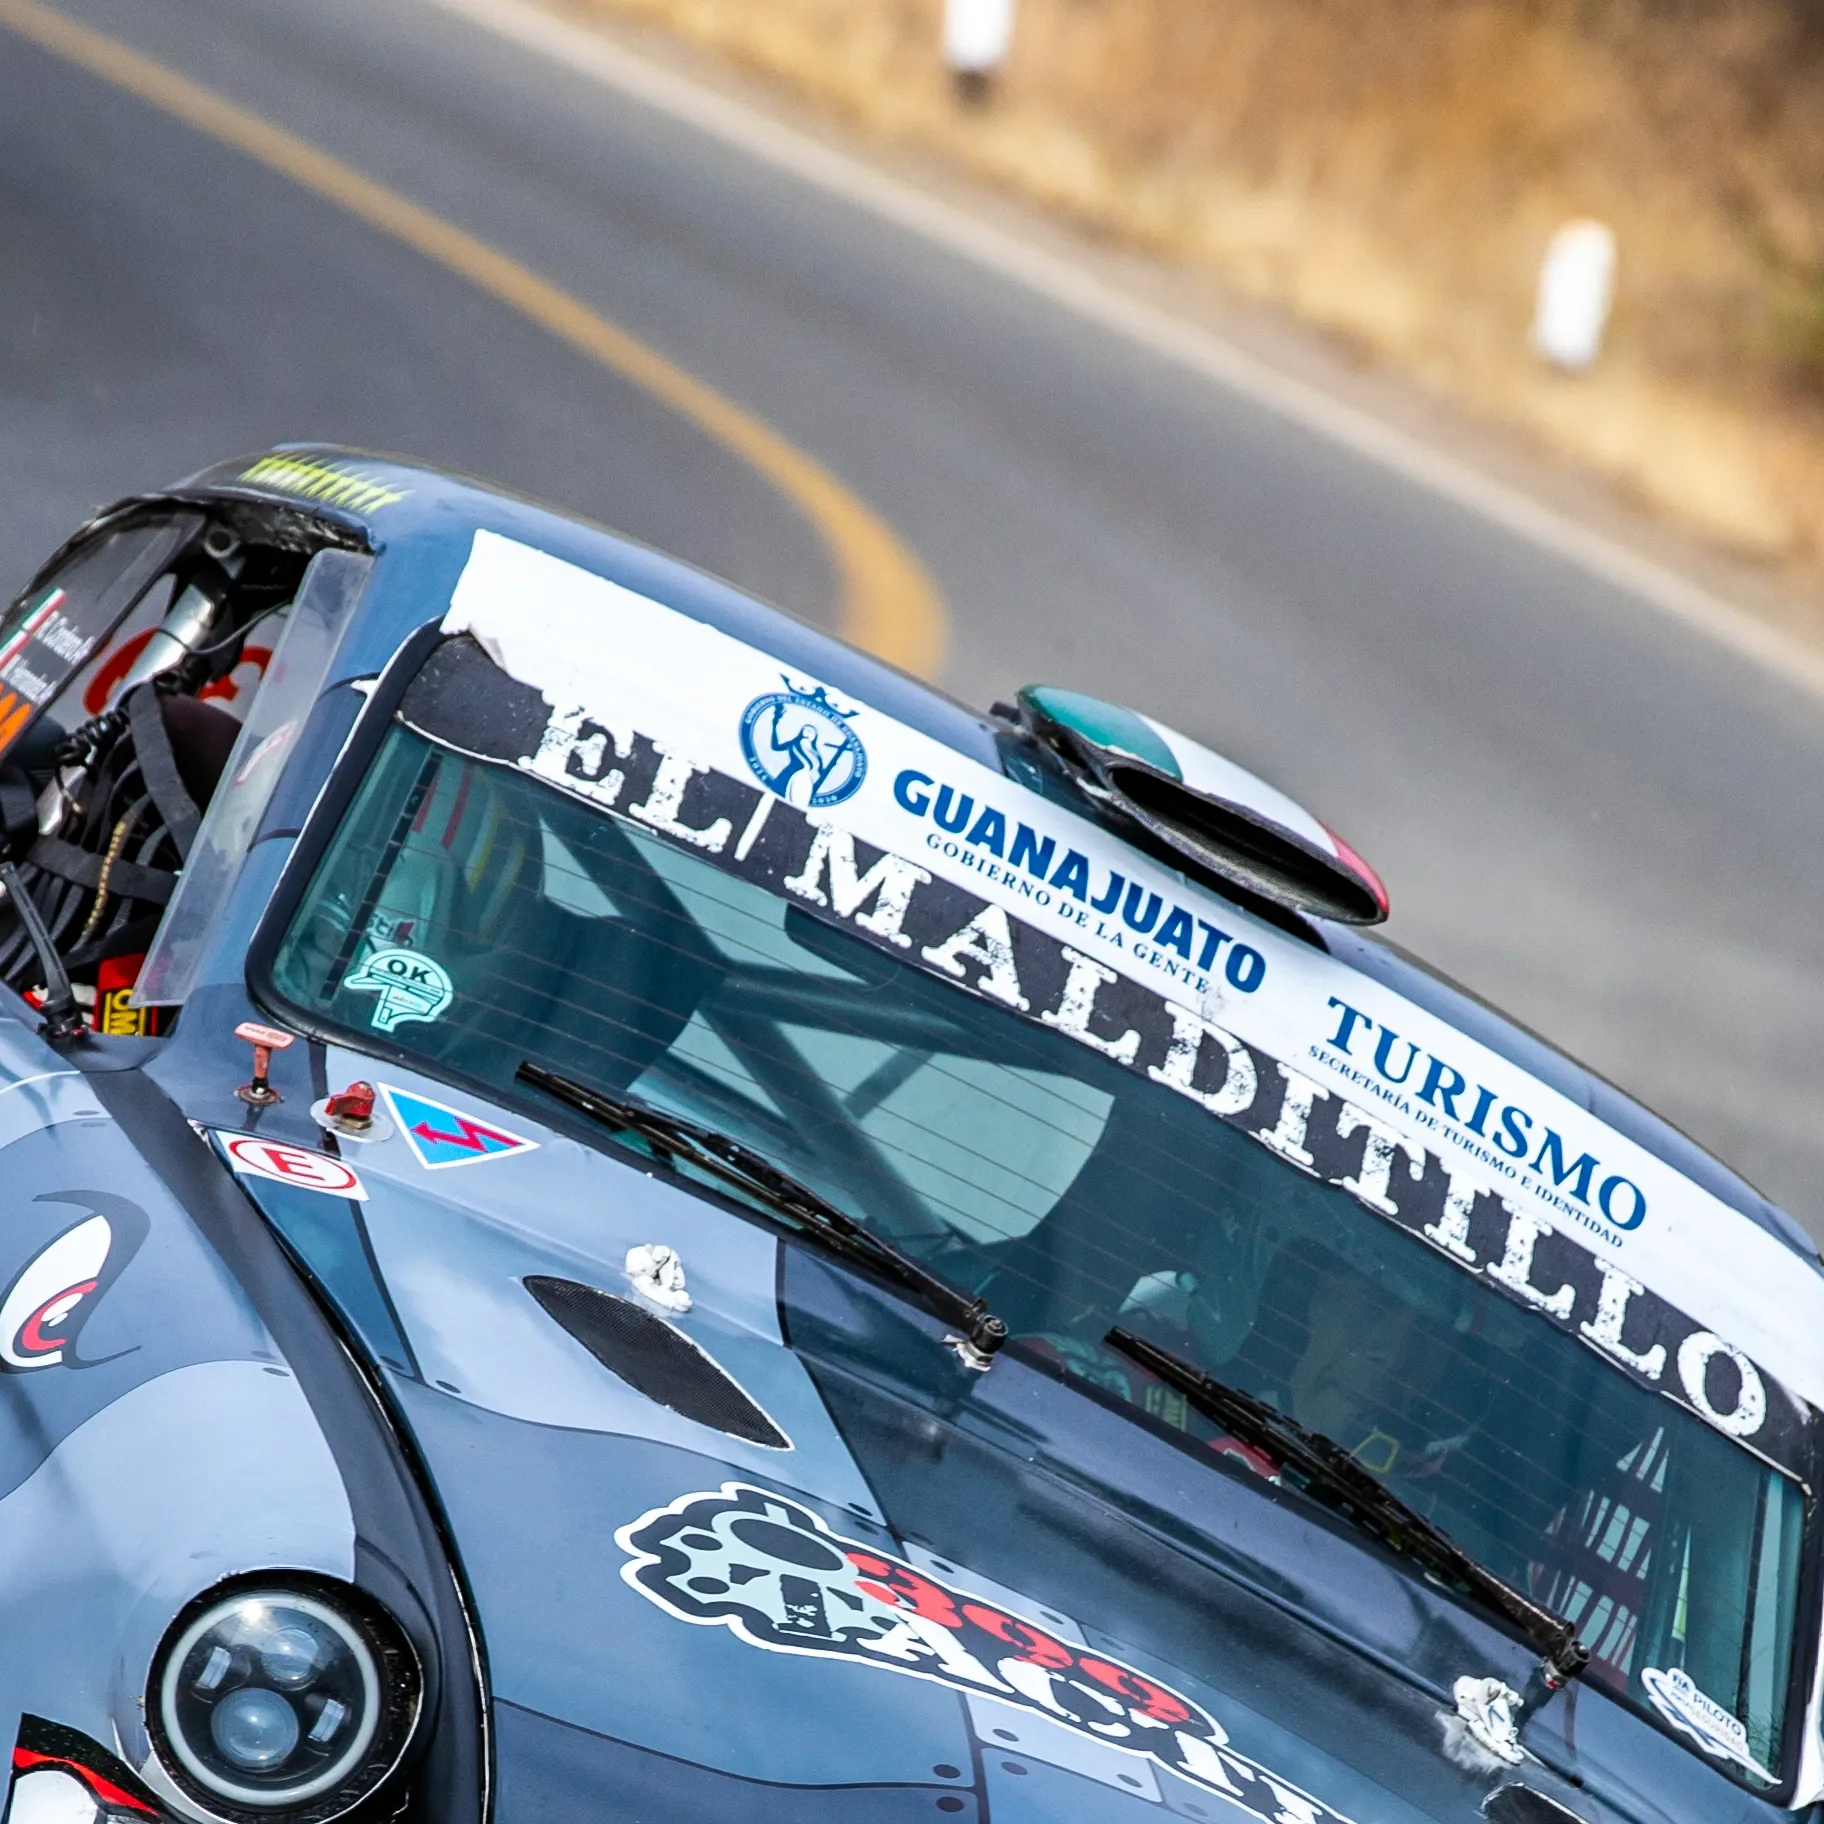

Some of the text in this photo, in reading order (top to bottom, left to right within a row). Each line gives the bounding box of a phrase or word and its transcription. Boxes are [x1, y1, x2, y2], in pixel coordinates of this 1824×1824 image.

[387, 958, 431, 984] OK
[893, 768, 1267, 994] GUANAJUATO
[926, 832, 1211, 995] GOBIERNO DE LA GENTE
[519, 704, 1768, 1438] EL MALDITILLO
[1308, 1044, 1624, 1249] SECRETARÍA DE TURISMO E IDENTIDAD
[1326, 995, 1648, 1232] TURISMO
[1692, 1692, 1742, 1737] PILOTO
